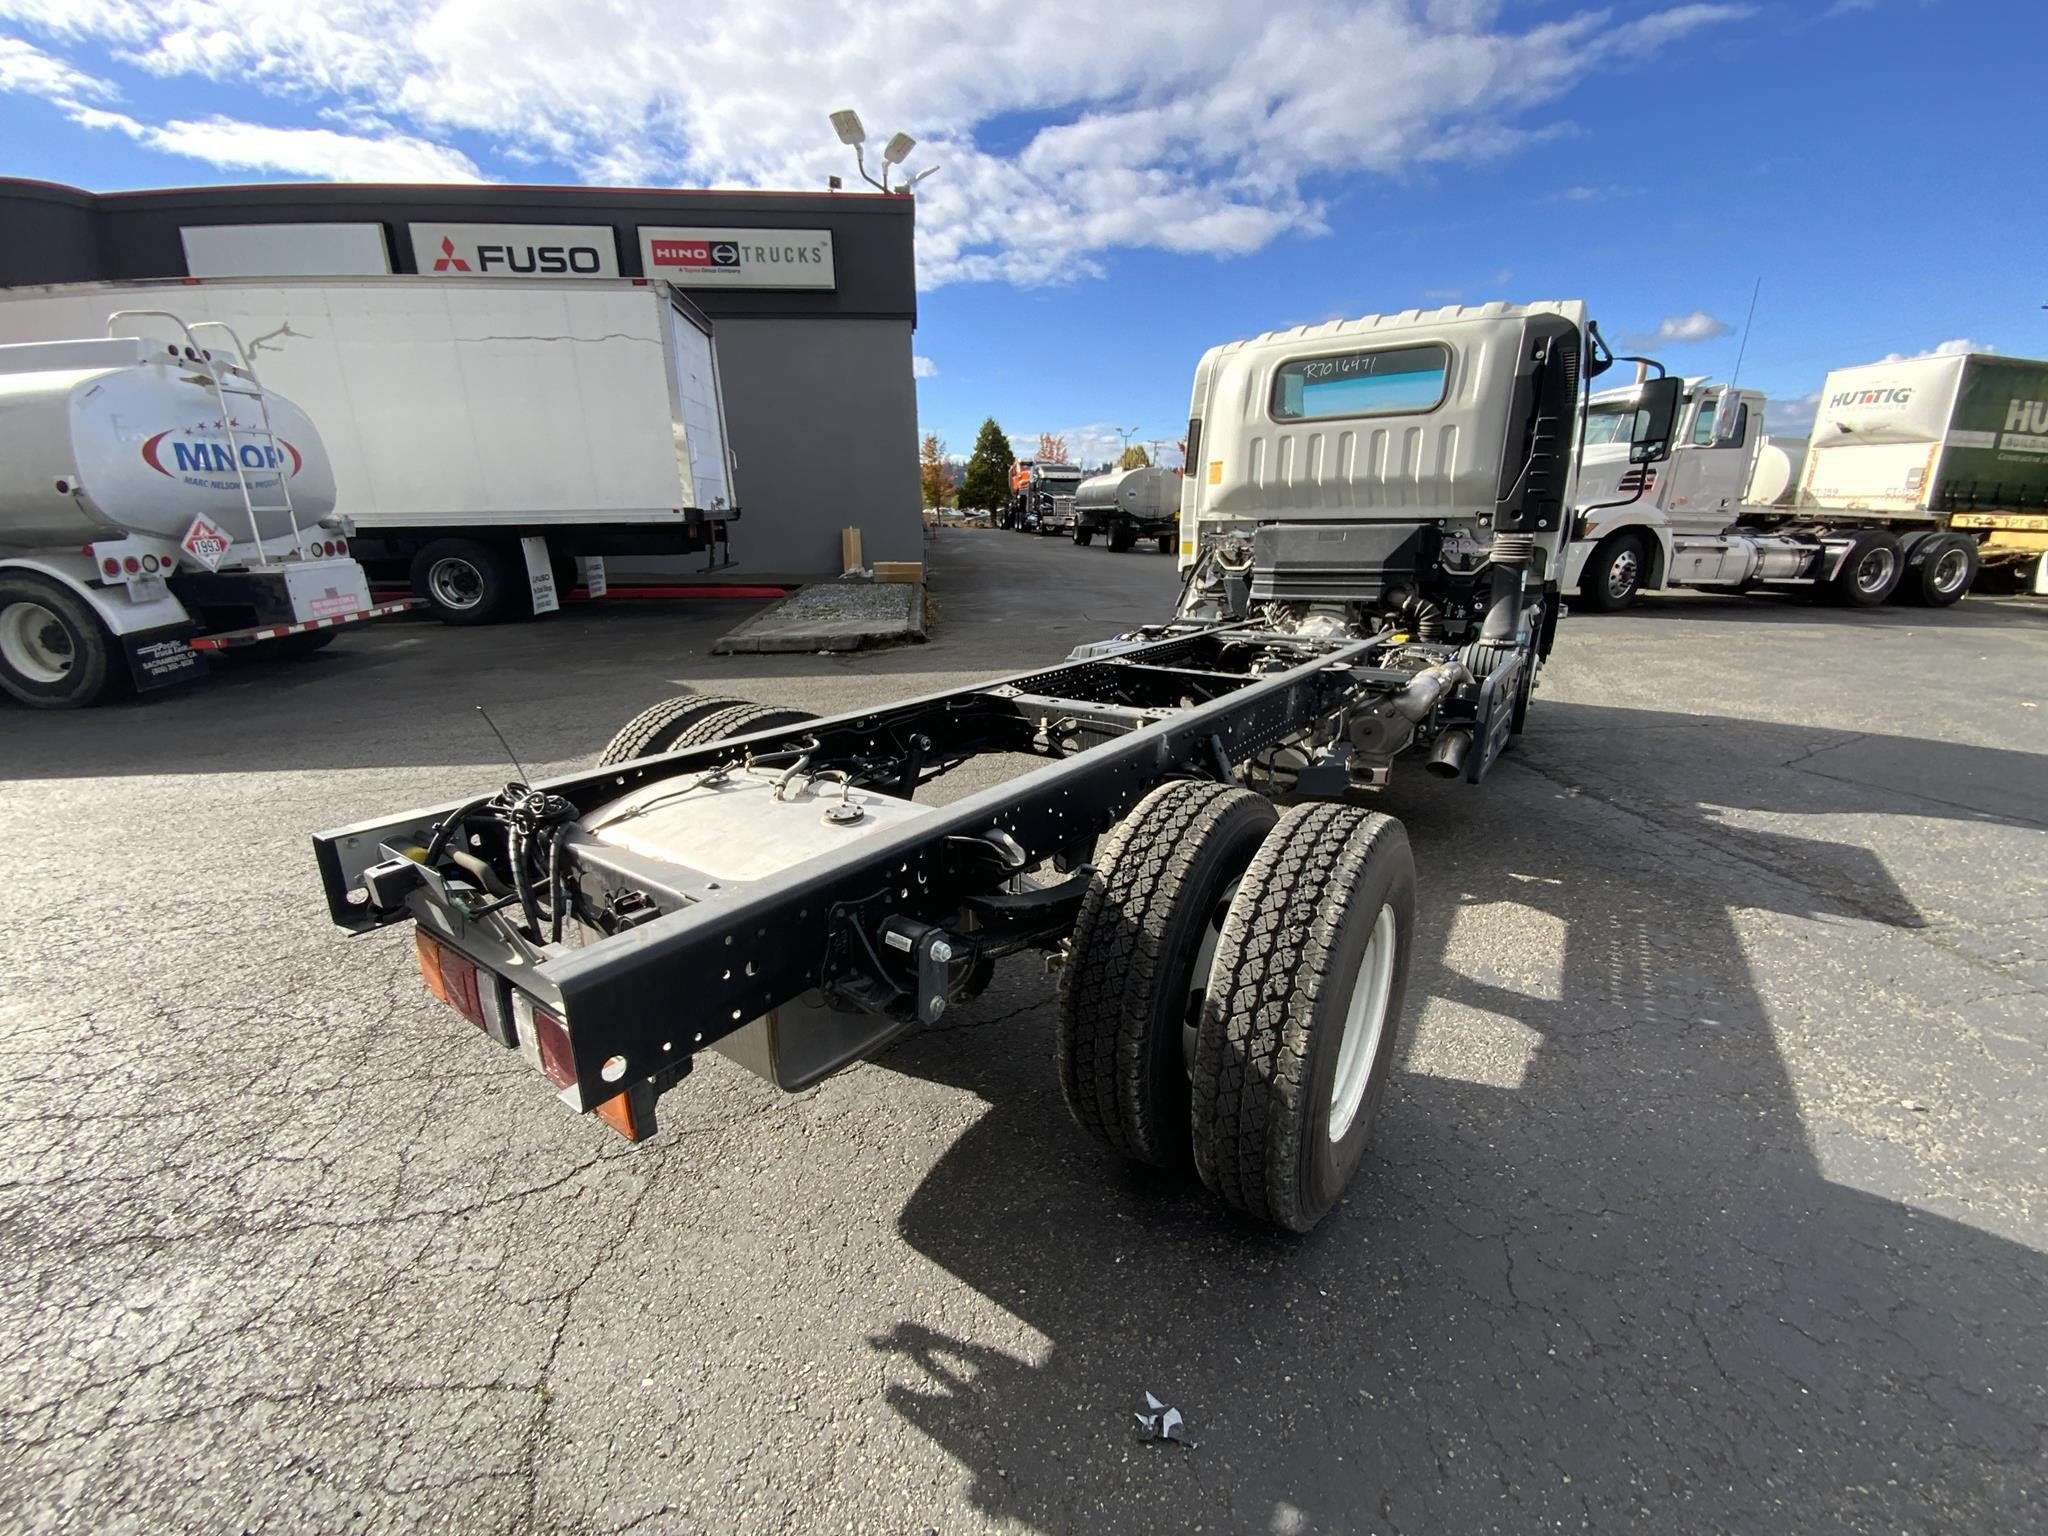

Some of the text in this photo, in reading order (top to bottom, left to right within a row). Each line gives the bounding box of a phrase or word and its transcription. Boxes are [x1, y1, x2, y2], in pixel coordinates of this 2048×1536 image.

[477, 245, 600, 273] FUSO
[656, 246, 822, 263] HINO TRUCKS
[1830, 388, 1912, 408] HUTTIG
[173, 442, 285, 472] MNOP
[194, 540, 220, 553] 1993
